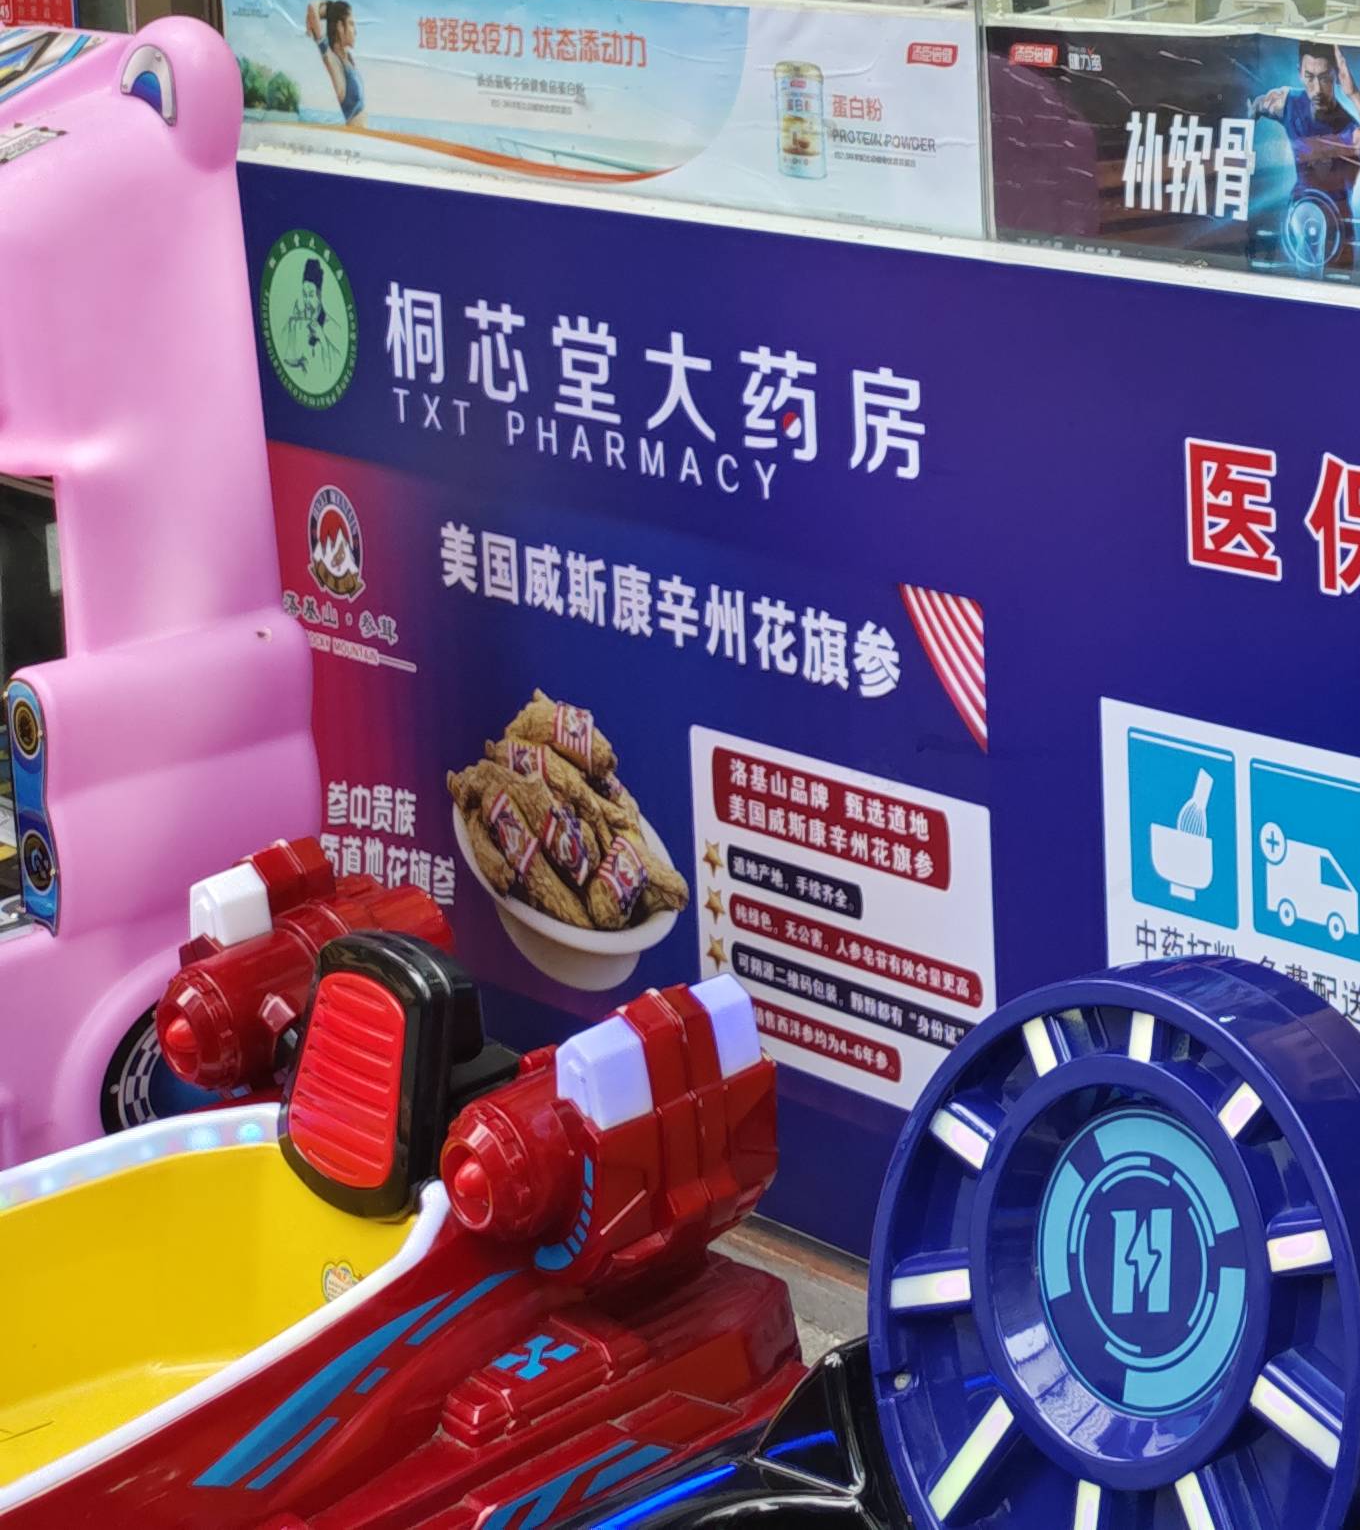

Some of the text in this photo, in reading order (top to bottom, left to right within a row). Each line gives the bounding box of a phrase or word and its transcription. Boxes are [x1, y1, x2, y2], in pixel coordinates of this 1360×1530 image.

[418, 16, 648, 68] 增强免疫力 状态添动力
[832, 94, 884, 122] 蛋白粉
[1121, 110, 1257, 222] 补软骨
[385, 281, 927, 481] 桐芯堂大药房
[392, 387, 778, 501] TXT PHARMACY
[440, 520, 902, 699] 美国威斯康辛州花旗参
[327, 780, 417, 838] 参中贵族
[727, 793, 935, 881] 美国威斯康辛州花旗参
[729, 757, 930, 843] 洛基山品牌 甄选道地
